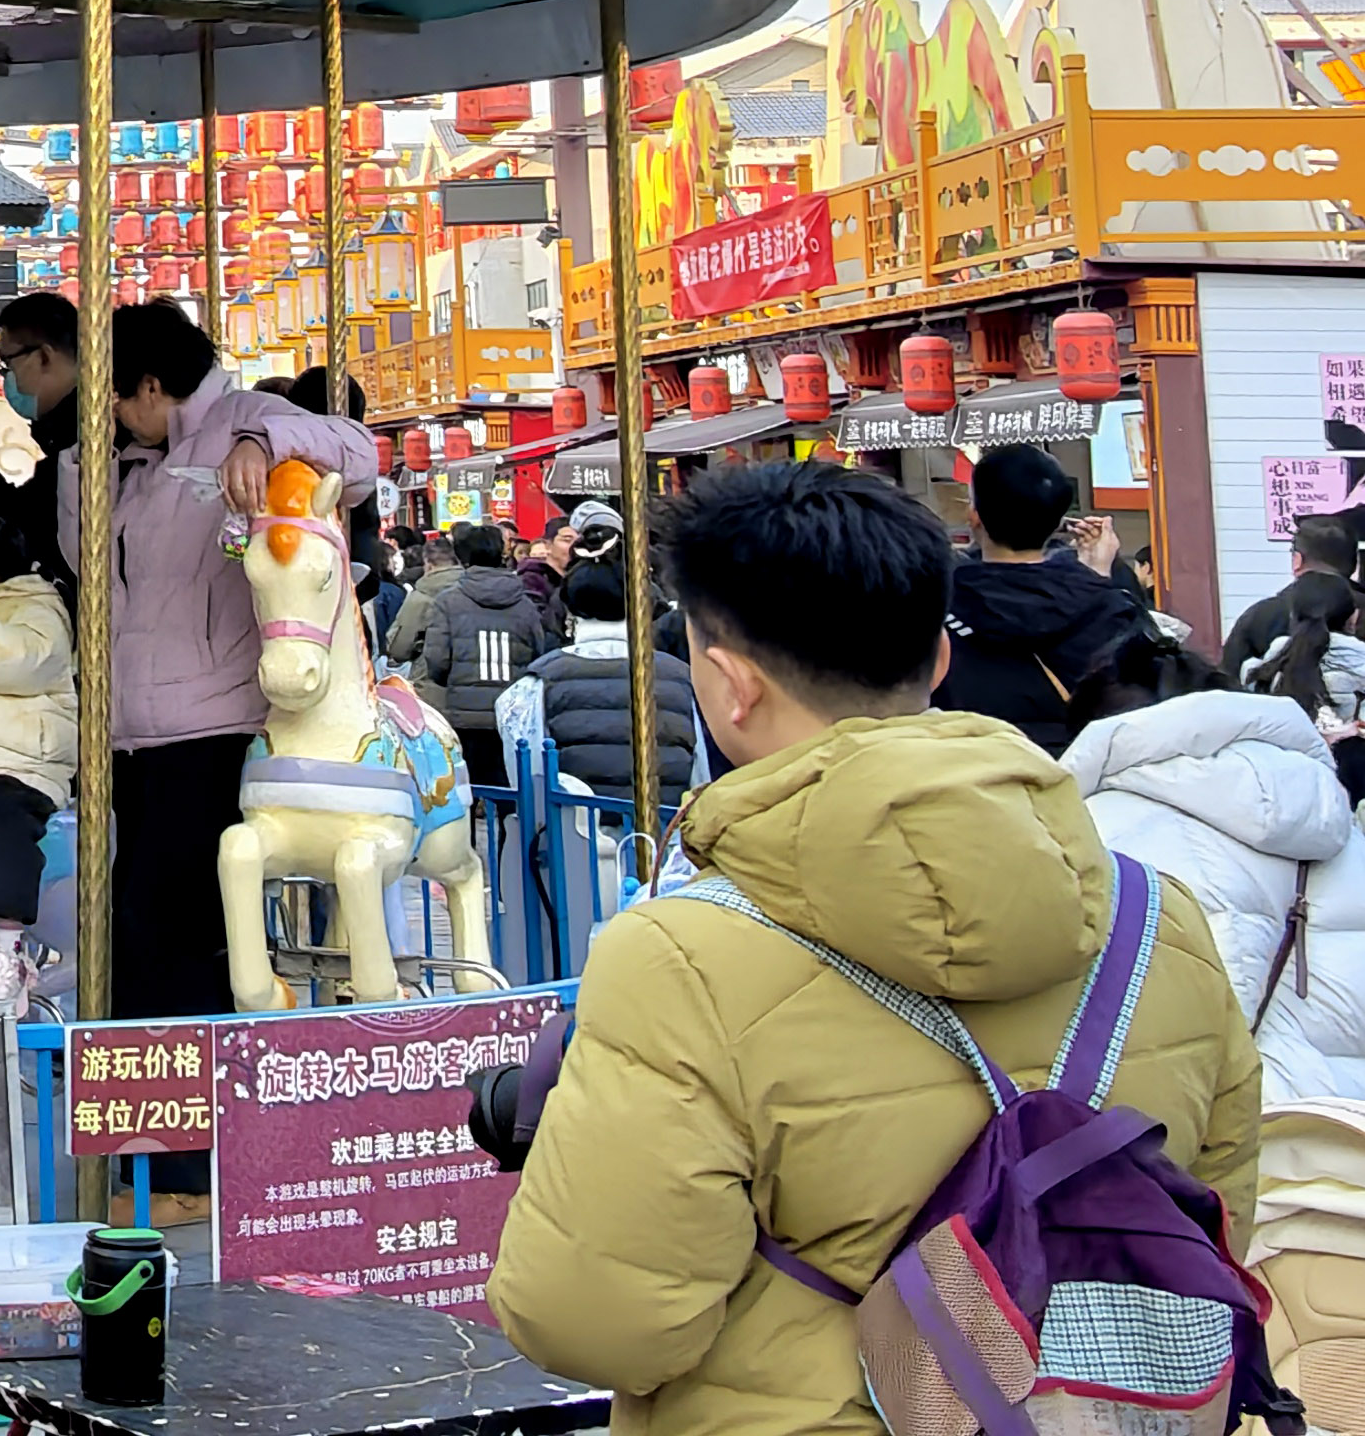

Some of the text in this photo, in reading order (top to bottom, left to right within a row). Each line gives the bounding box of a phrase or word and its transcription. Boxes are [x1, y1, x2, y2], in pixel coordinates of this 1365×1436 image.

[80, 1042, 204, 1083] 游玩价格
[73, 1096, 212, 1136] 每位/20元
[375, 1216, 459, 1255] 安全规定
